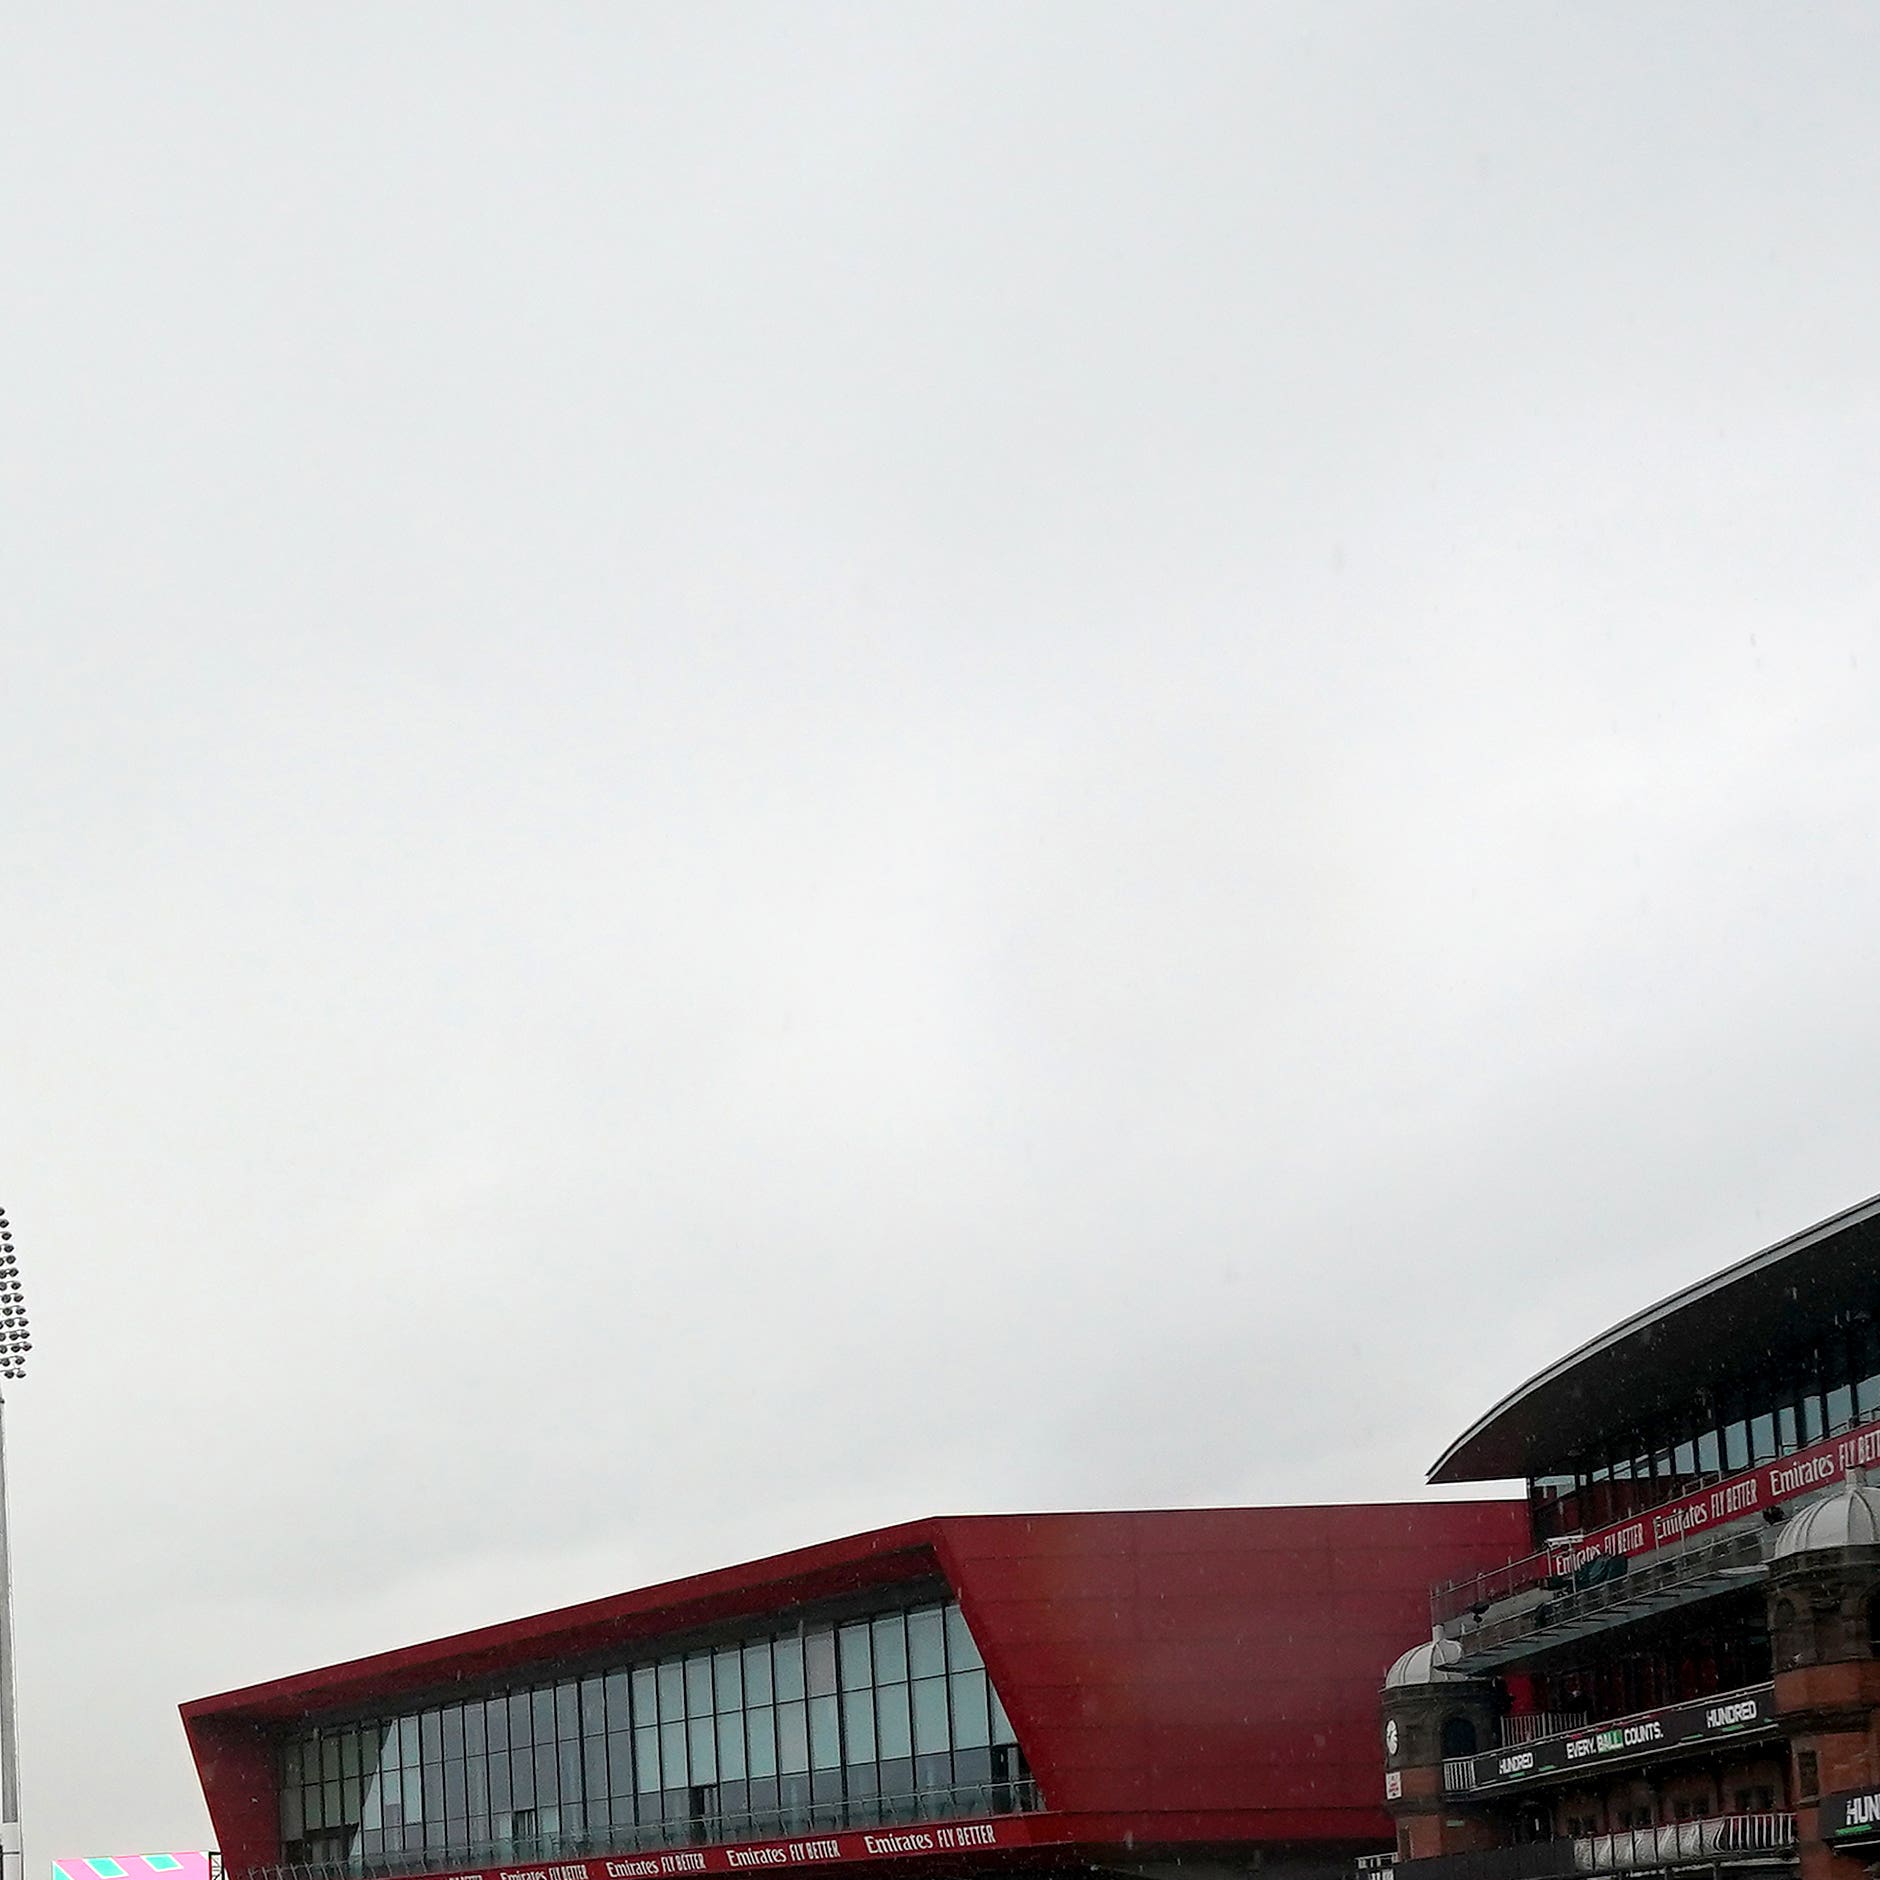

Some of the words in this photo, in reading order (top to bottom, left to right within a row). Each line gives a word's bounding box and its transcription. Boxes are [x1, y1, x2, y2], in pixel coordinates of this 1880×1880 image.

[1769, 1453, 1834, 1497] Emirates
[1838, 1440, 1856, 1471] FLY
[1654, 1502, 1708, 1539] Emirates
[1710, 1492, 1725, 1518] FLY
[1726, 1478, 1758, 1513] BETTER
[1706, 1700, 1758, 1729] HUNDRED
[1566, 1738, 1597, 1759] EVERY.
[1624, 1721, 1664, 1747] COUNTS.
[726, 1848, 787, 1867] Emirates
[789, 1844, 805, 1861] FLY
[805, 1840, 840, 1860] BETTER
[864, 1833, 933, 1854] Emirates
[936, 1829, 955, 1847] FLY
[957, 1824, 996, 1845] BETTER
[606, 1859, 659, 1878] Emirates
